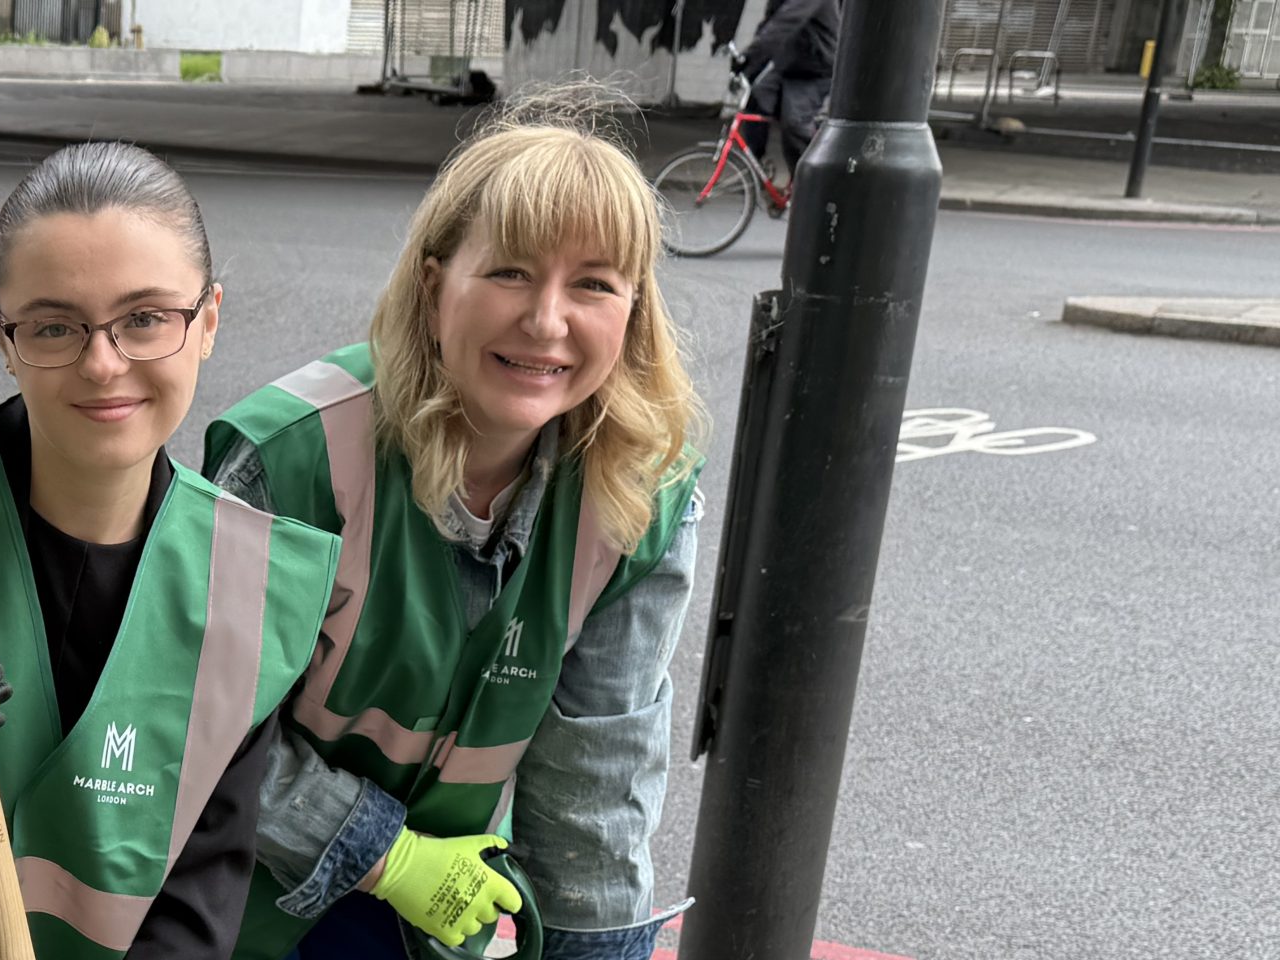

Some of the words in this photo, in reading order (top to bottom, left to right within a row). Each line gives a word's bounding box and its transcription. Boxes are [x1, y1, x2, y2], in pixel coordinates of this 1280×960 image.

[501, 665, 537, 679] ARCH
[73, 775, 117, 793] MARBLE
[117, 782, 155, 797] ARCH
[97, 795, 127, 805] LONDON
[448, 870, 488, 928] DEKTON
